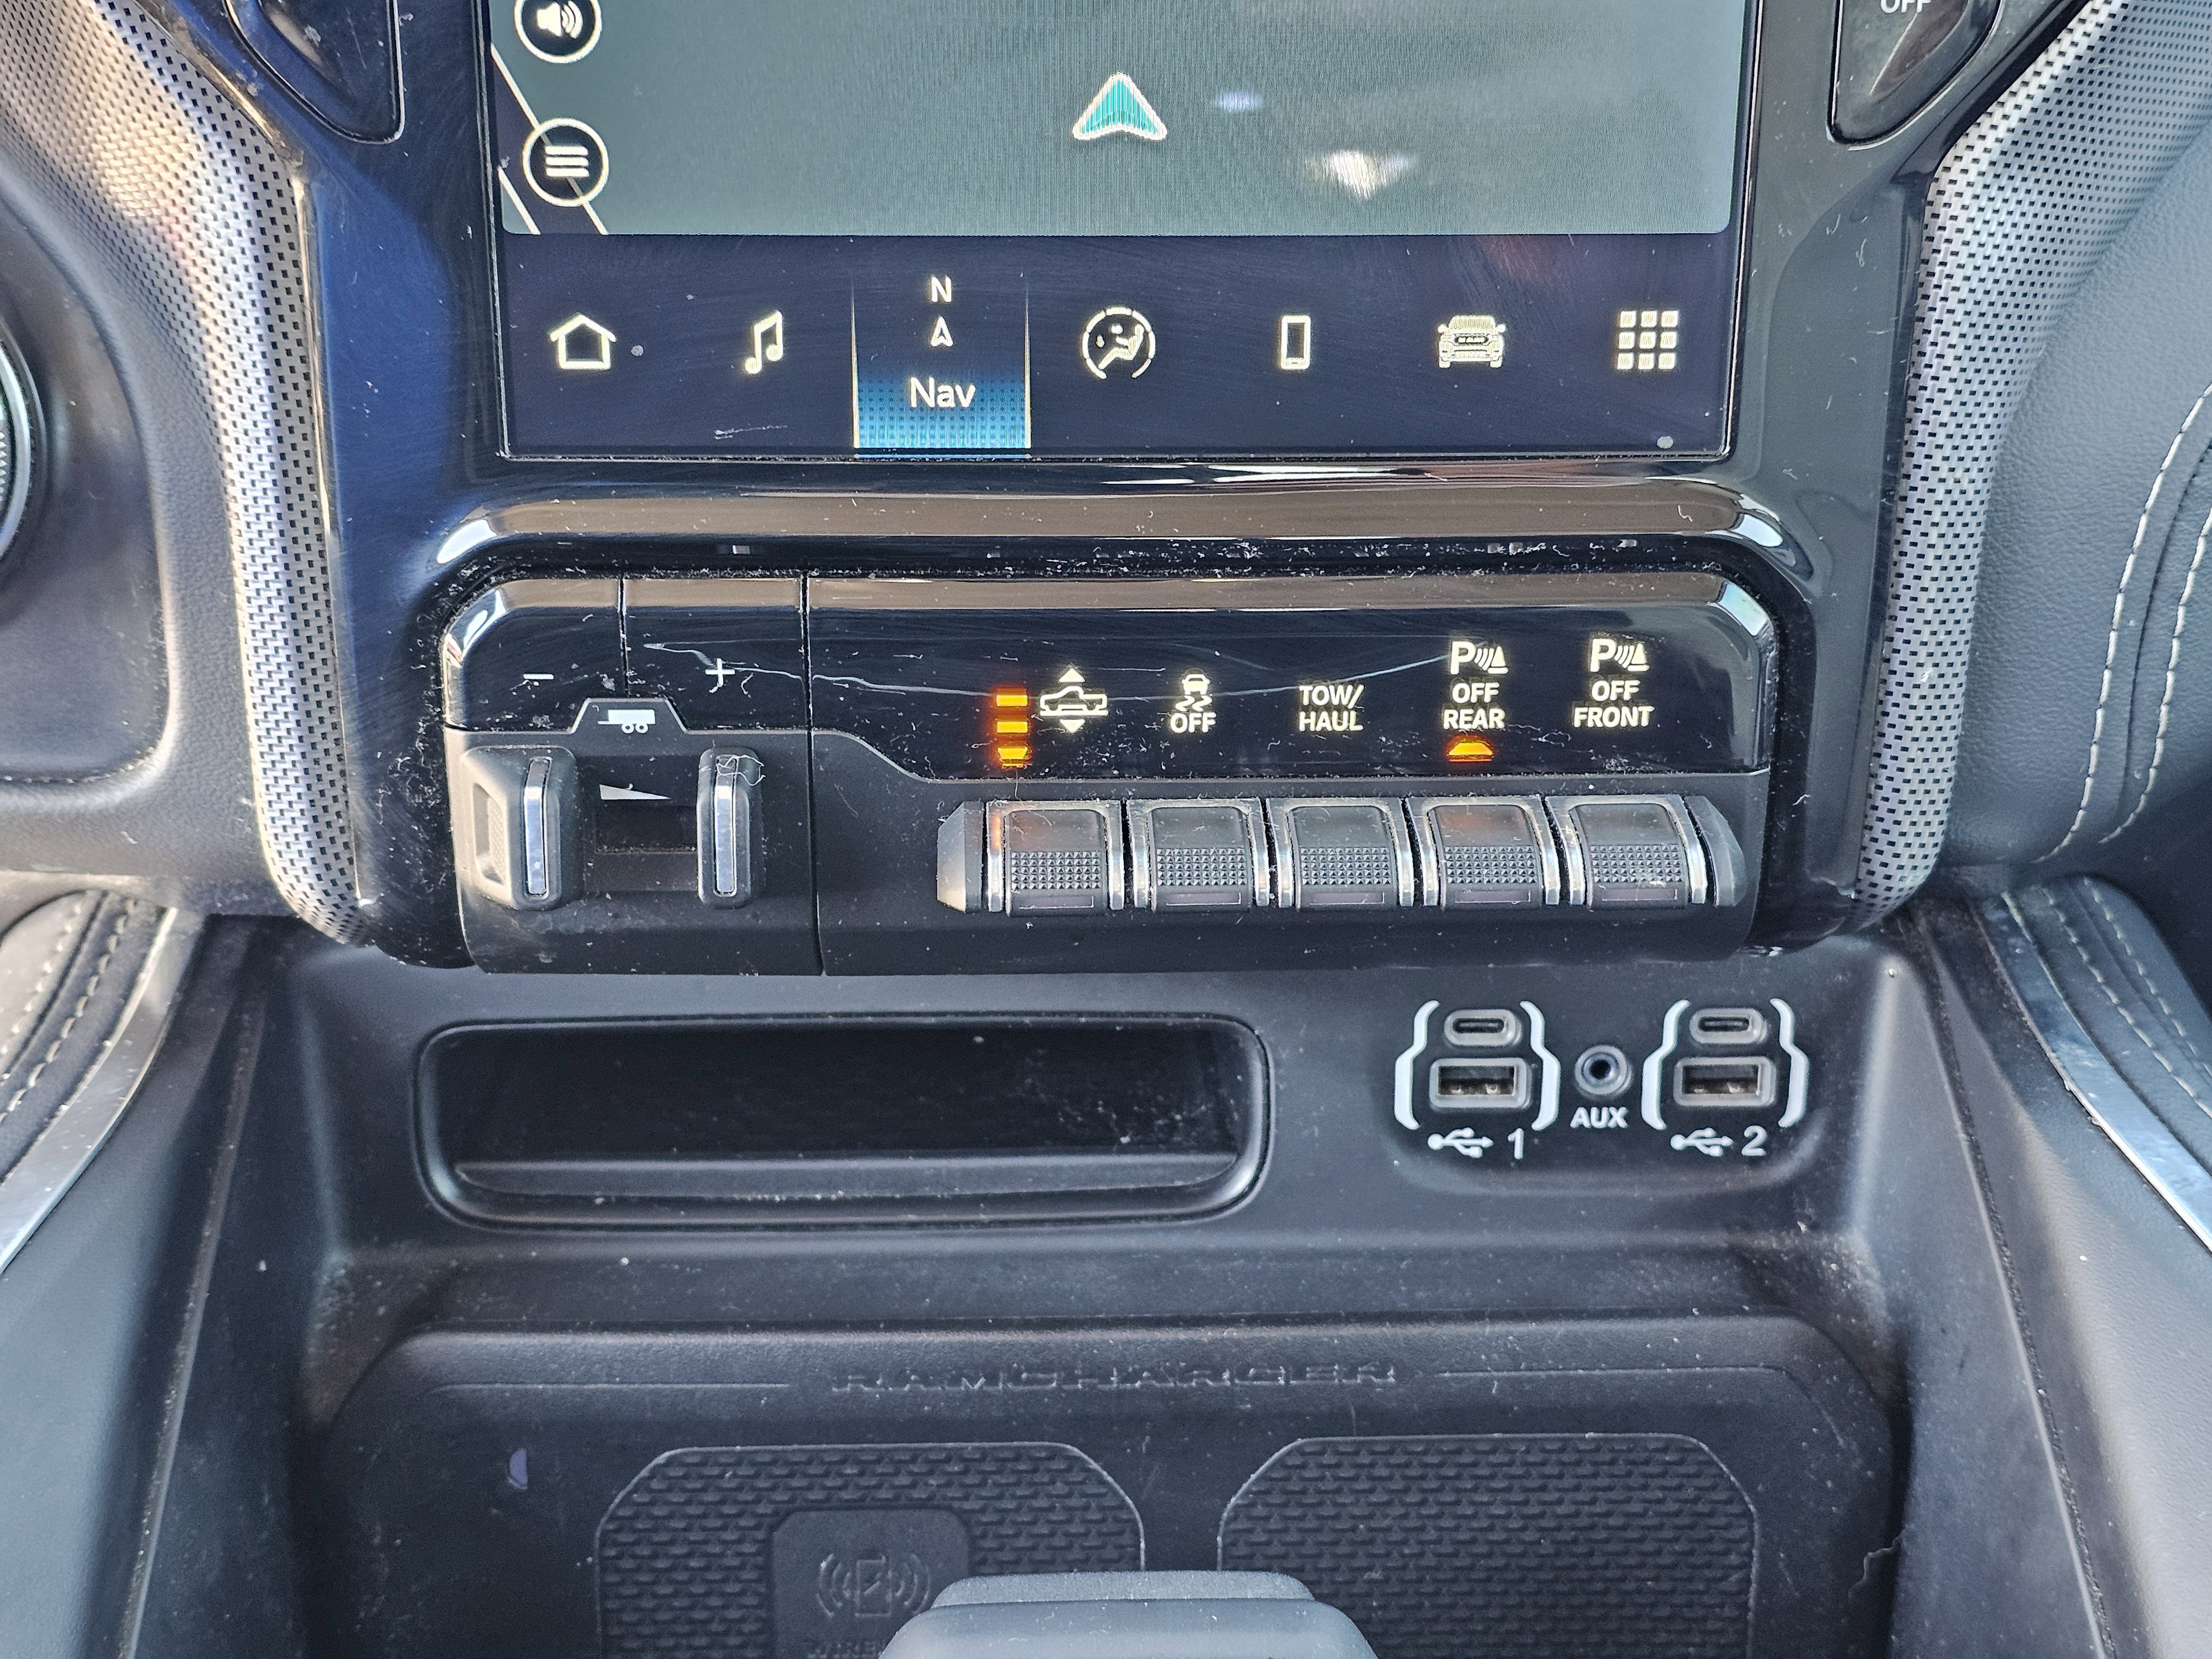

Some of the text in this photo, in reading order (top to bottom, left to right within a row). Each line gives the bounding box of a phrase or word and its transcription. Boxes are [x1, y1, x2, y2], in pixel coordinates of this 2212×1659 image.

[931, 276, 952, 302] N
[910, 377, 976, 408] Nav
[1450, 641, 1475, 675] P
[1590, 639, 1616, 672] P
[1299, 685, 1364, 709] TOW/
[1452, 681, 1500, 703] OFF
[1591, 680, 1640, 702] OFF
[1170, 712, 1217, 733] OFF
[1298, 711, 1364, 732] HAUL
[1443, 708, 1505, 730] REAR
[1574, 706, 1655, 728] FRONT
[1571, 1107, 1629, 1129] AUX
[1507, 1128, 1524, 1160] 1
[1741, 1126, 1767, 1156] 2
